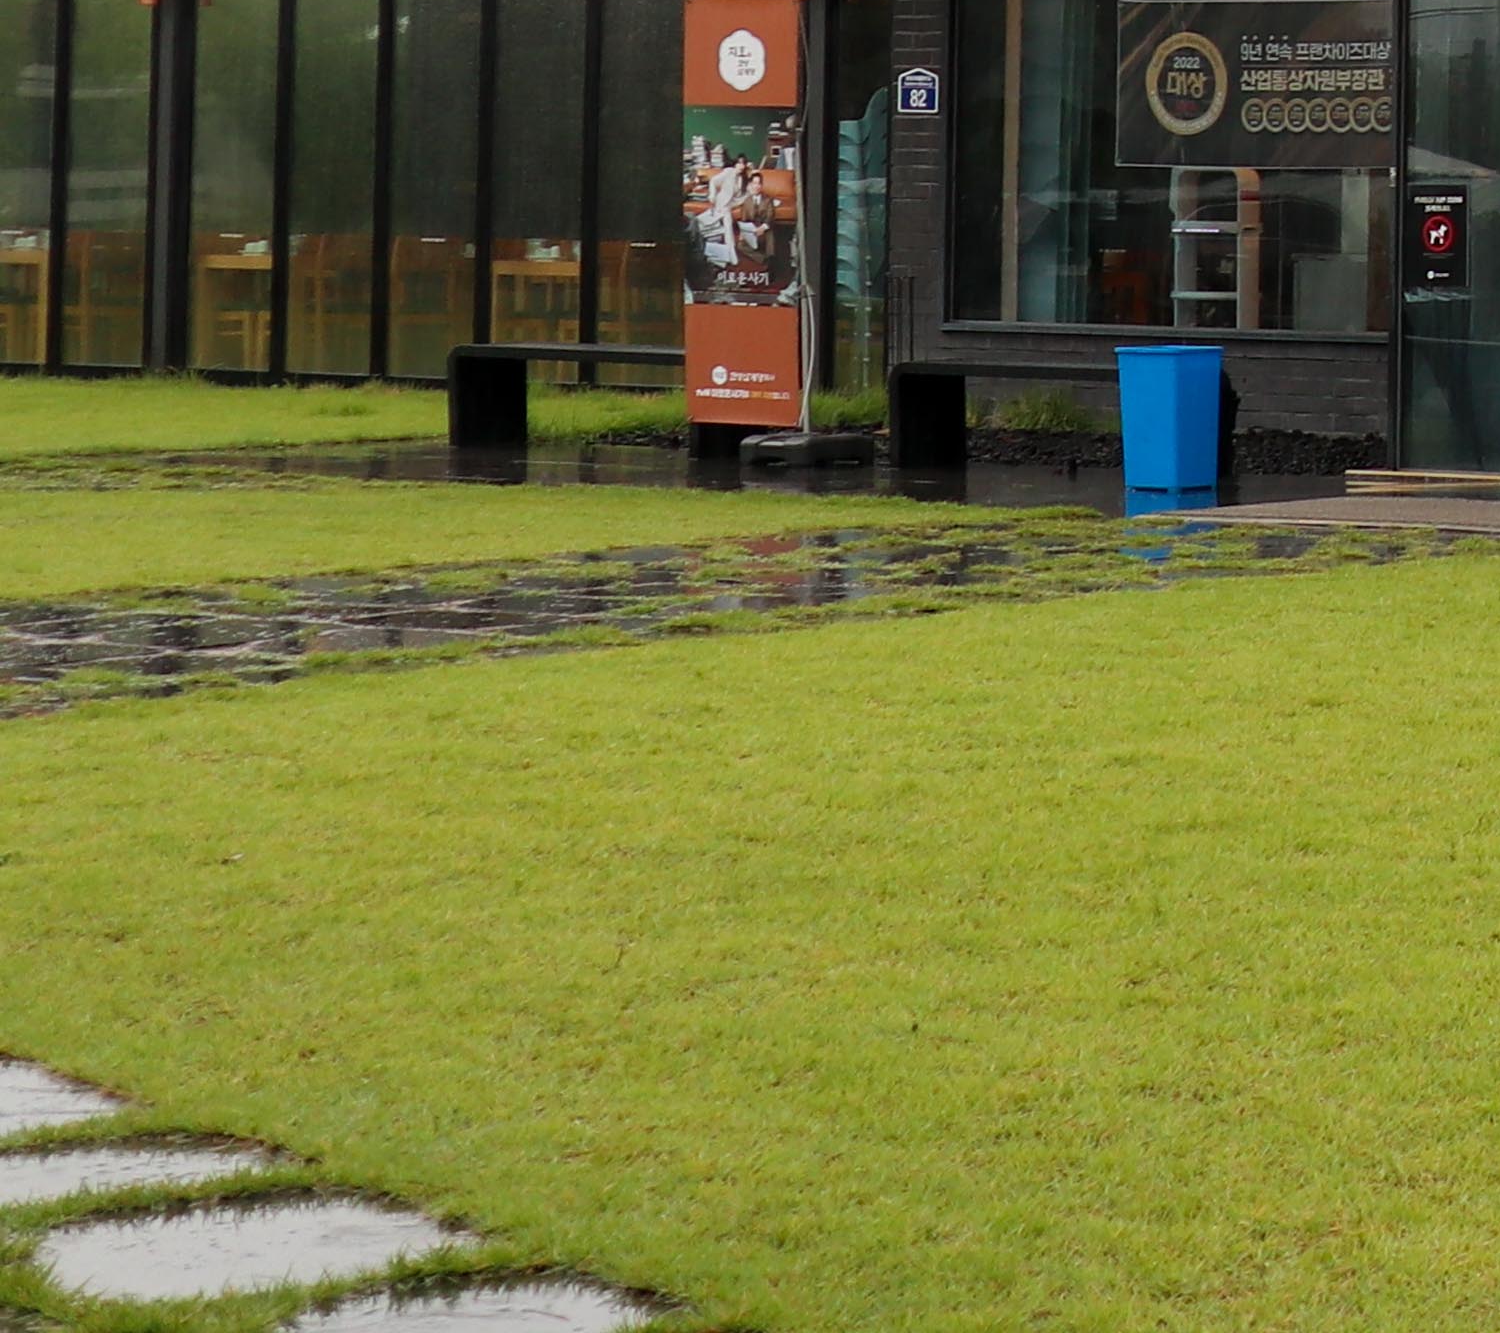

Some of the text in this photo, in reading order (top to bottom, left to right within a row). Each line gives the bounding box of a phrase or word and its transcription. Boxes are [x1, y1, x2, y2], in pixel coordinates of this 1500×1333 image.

[1240, 41, 1393, 62] 9년 연속 프랜차이즈대상
[1173, 56, 1200, 69] 2022
[1166, 71, 1208, 99] 대상
[1240, 67, 1385, 91] 산업통상자원부장관
[910, 89, 927, 107] 82
[717, 271, 769, 285] 이로운사기
